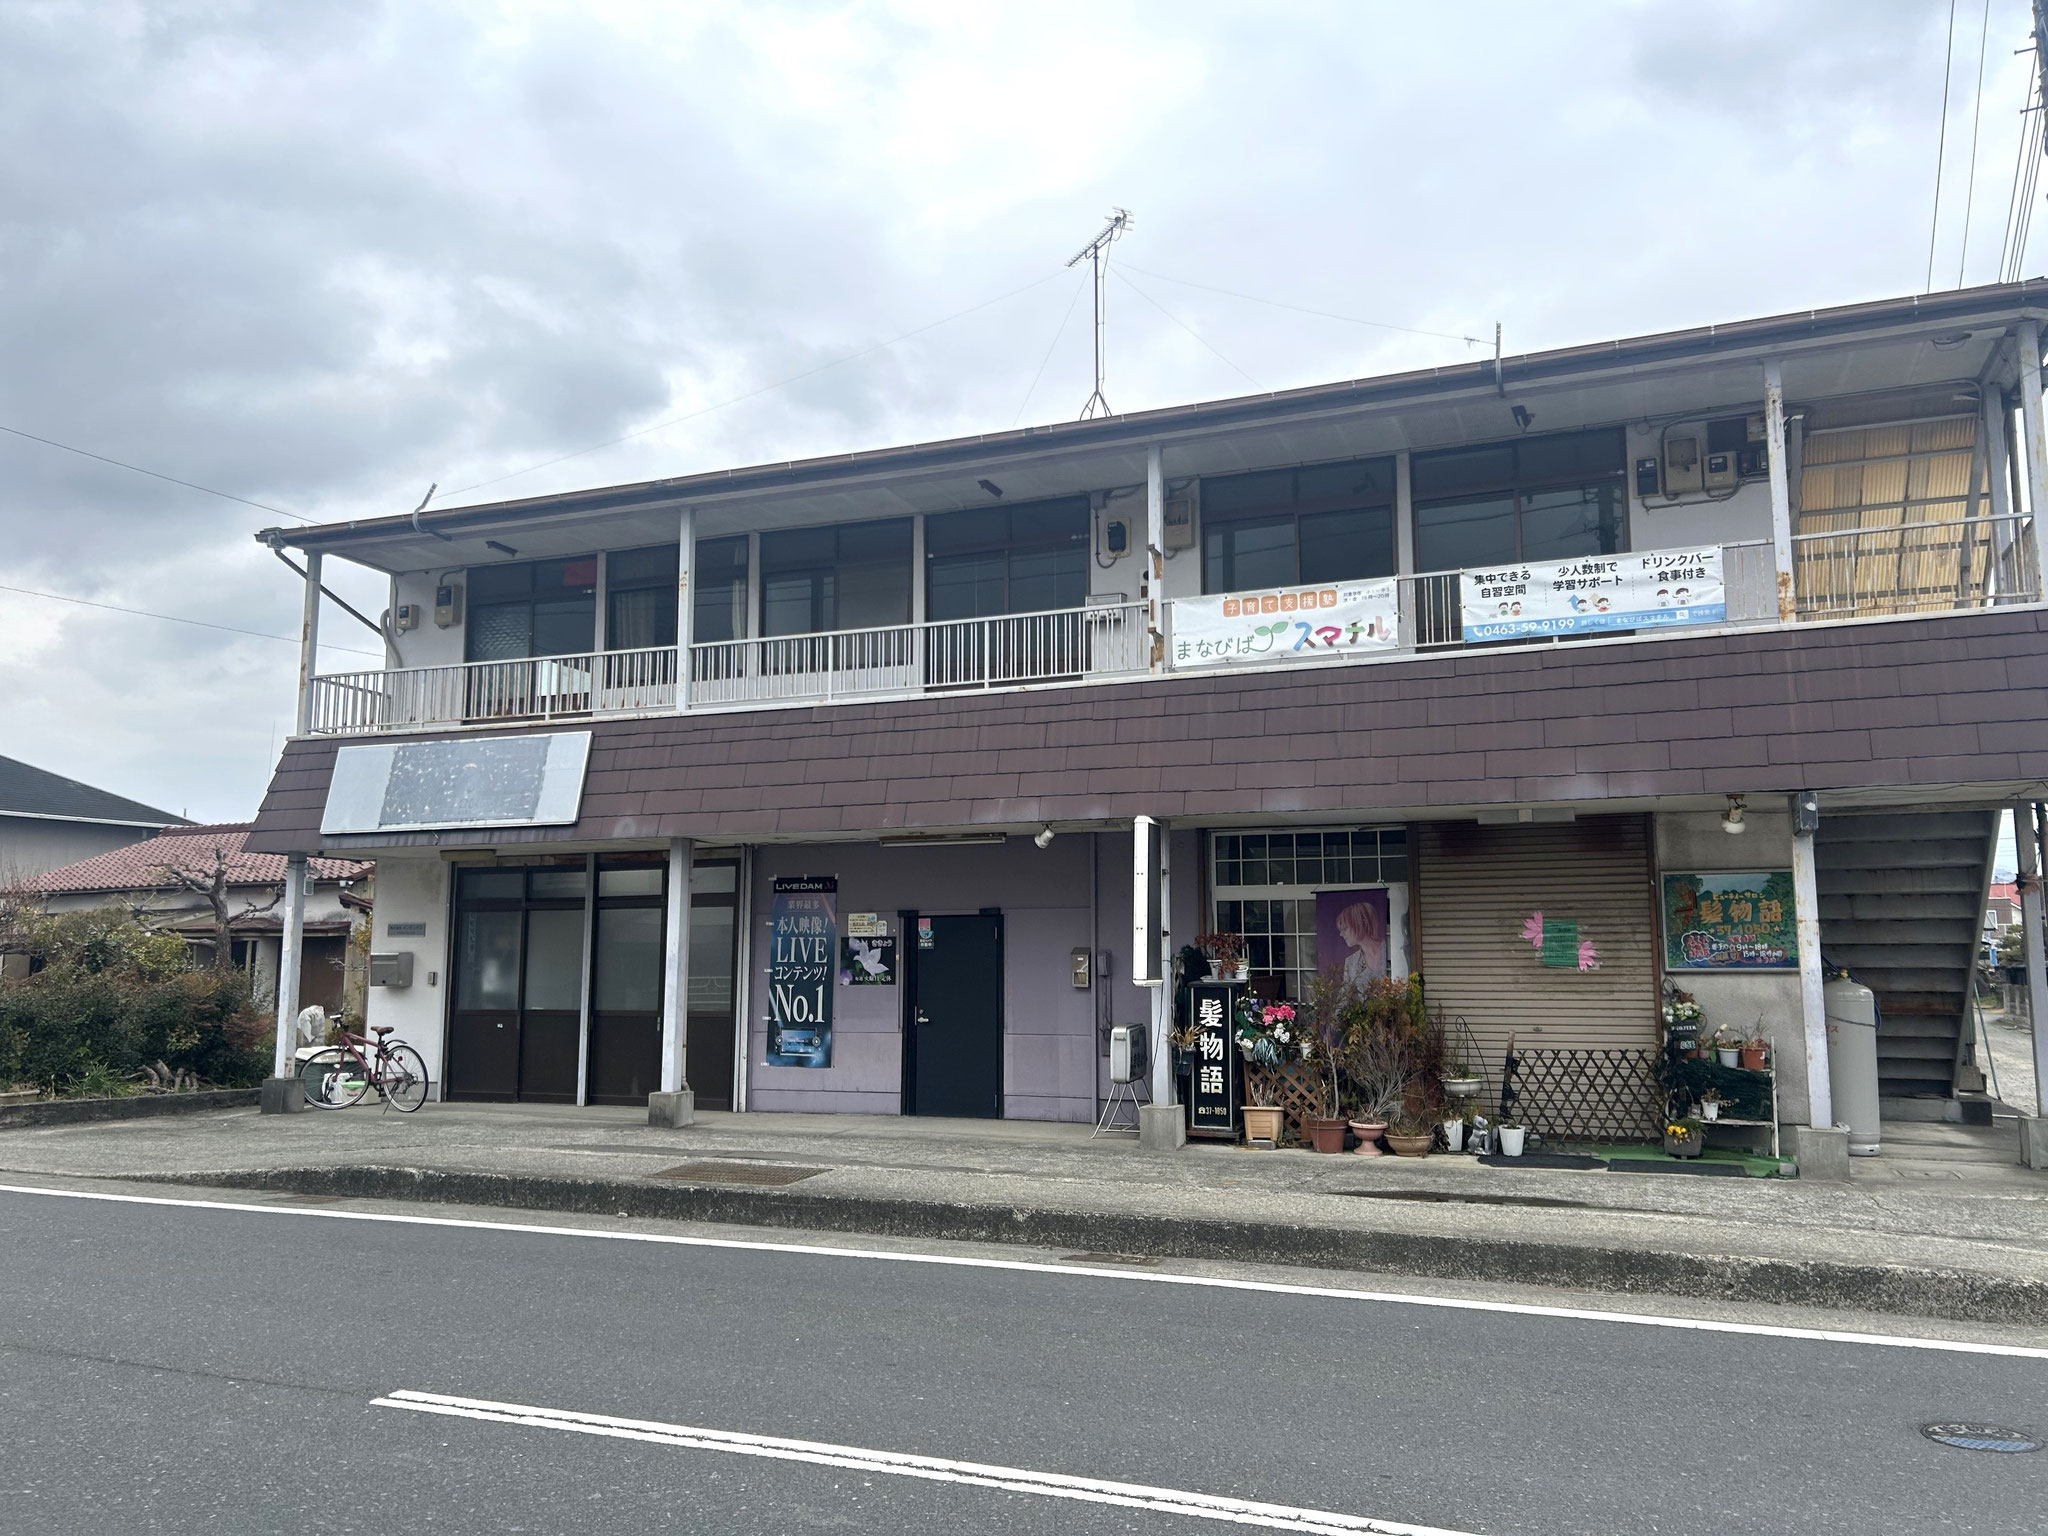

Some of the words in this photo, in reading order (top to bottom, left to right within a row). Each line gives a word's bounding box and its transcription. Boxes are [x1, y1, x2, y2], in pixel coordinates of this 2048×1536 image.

[1558, 561, 1618, 578] 少人数制で
[1642, 551, 1714, 570] ドリンクバー
[1474, 570, 1532, 587] 集中できる
[1552, 575, 1623, 593] 学習サポート
[1480, 584, 1527, 600] 自習空間
[1226, 590, 1337, 616] 子育て支援塾
[1484, 618, 1575, 637] 0463-59-9199
[1177, 634, 1256, 661] まなびば
[1699, 898, 1783, 924] 髪物語
[776, 916, 828, 935] 本人映像！
[1715, 922, 1772, 936] 37-1050
[776, 936, 828, 964] LIVE
[774, 966, 826, 981] コンテンツ！
[773, 983, 825, 1023] No.1
[1199, 998, 1224, 1095] 髪物語
[1205, 1106, 1227, 1116] 37-1050
